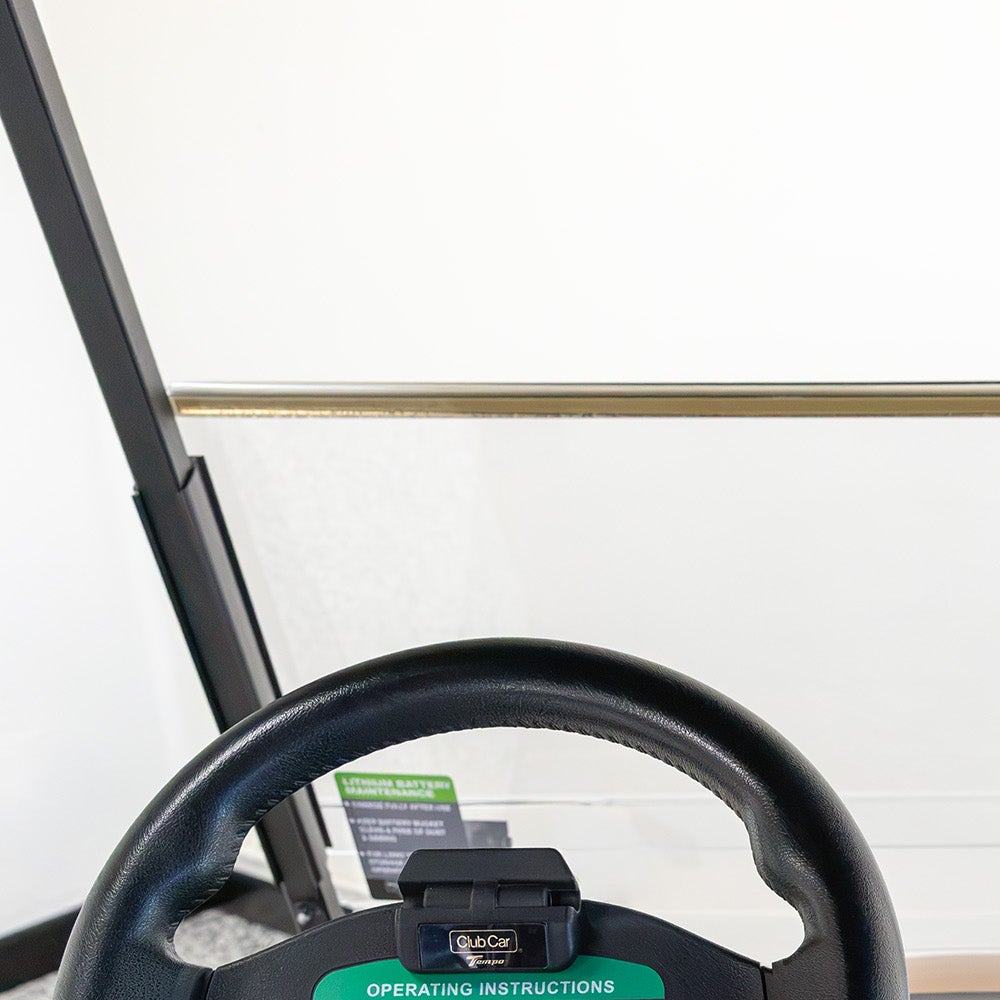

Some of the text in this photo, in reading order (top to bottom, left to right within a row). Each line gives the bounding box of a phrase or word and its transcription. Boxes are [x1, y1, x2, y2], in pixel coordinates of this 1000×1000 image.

[456, 934, 510, 948] Club Car
[466, 955, 505, 968] Tempo
[366, 980, 614, 997] OPERATING INSTRUCTIONS
